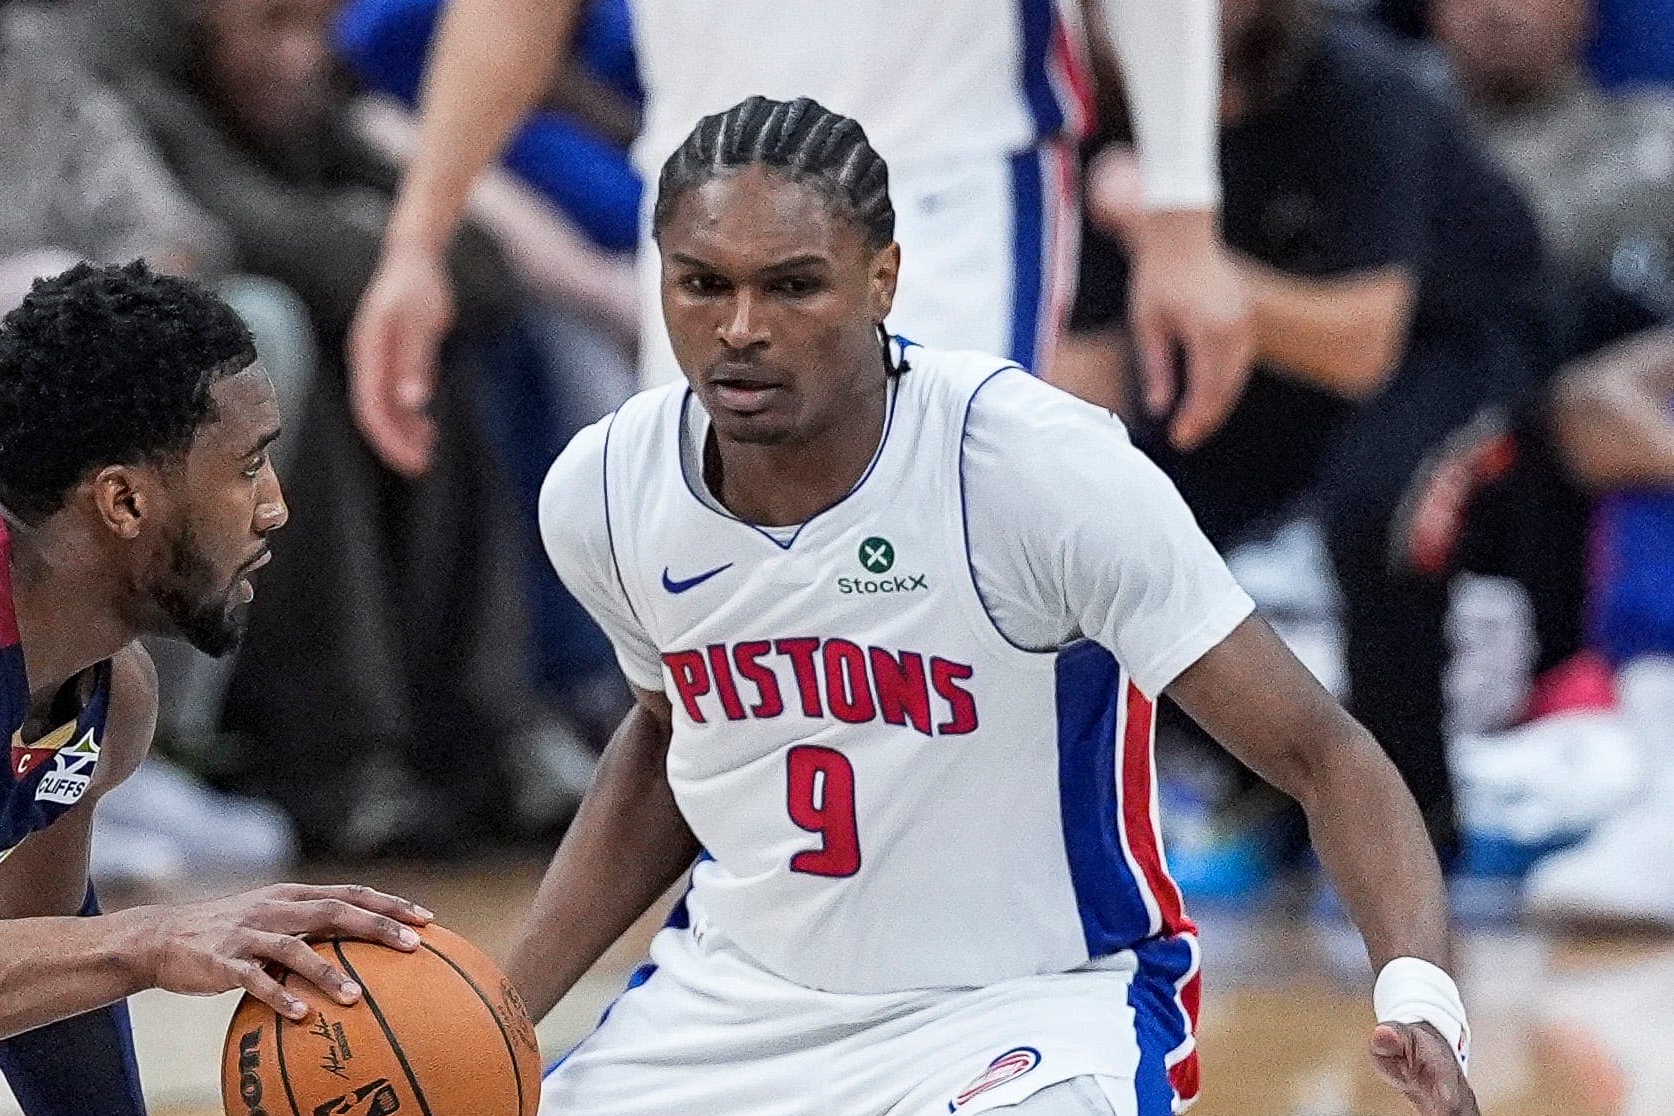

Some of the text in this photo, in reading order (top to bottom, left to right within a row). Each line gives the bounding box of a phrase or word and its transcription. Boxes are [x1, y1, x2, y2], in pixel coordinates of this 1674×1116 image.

[837, 573, 928, 595] StockX
[661, 636, 980, 737] PISTONS
[37, 777, 86, 798] CLIFFS
[785, 744, 862, 878] 9
